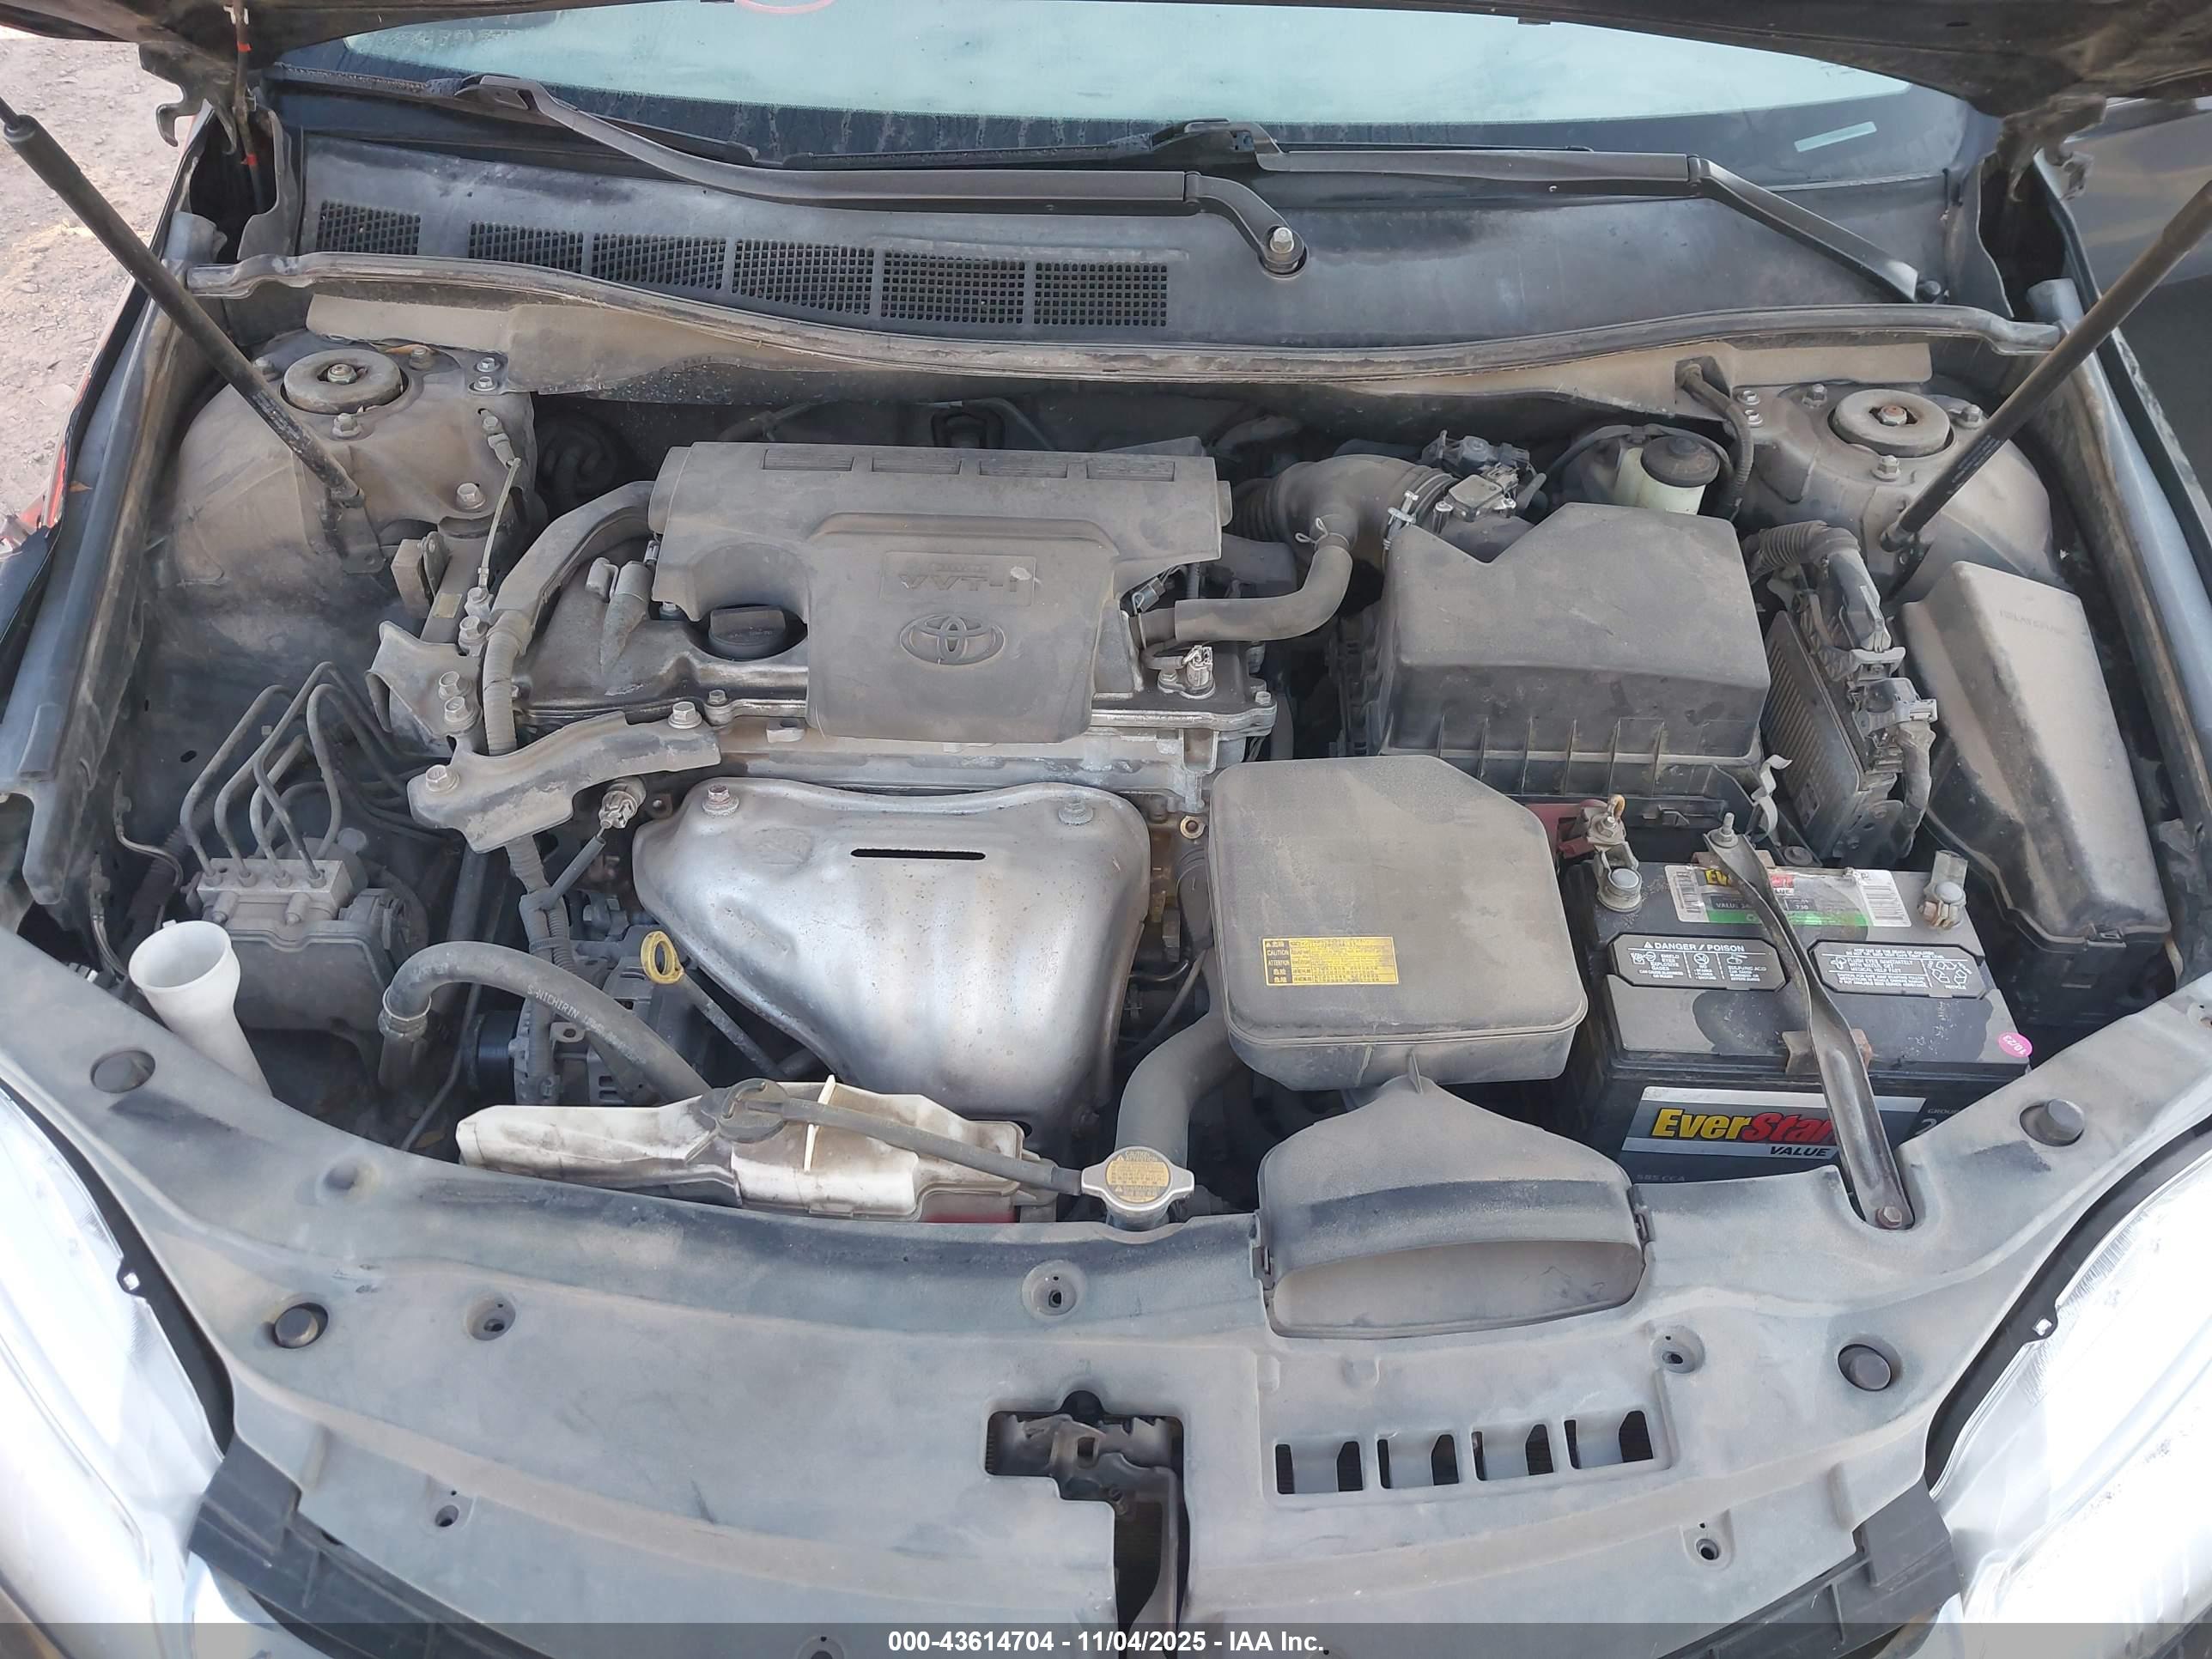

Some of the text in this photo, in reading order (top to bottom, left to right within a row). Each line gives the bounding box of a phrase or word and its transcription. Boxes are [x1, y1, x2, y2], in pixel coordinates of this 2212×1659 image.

[1654, 942, 1697, 951] DANGER
[1651, 1108, 1835, 1143] EverStar
[1915, 1118, 1937, 1135] 2
[1770, 1146, 1832, 1157] VALUE
